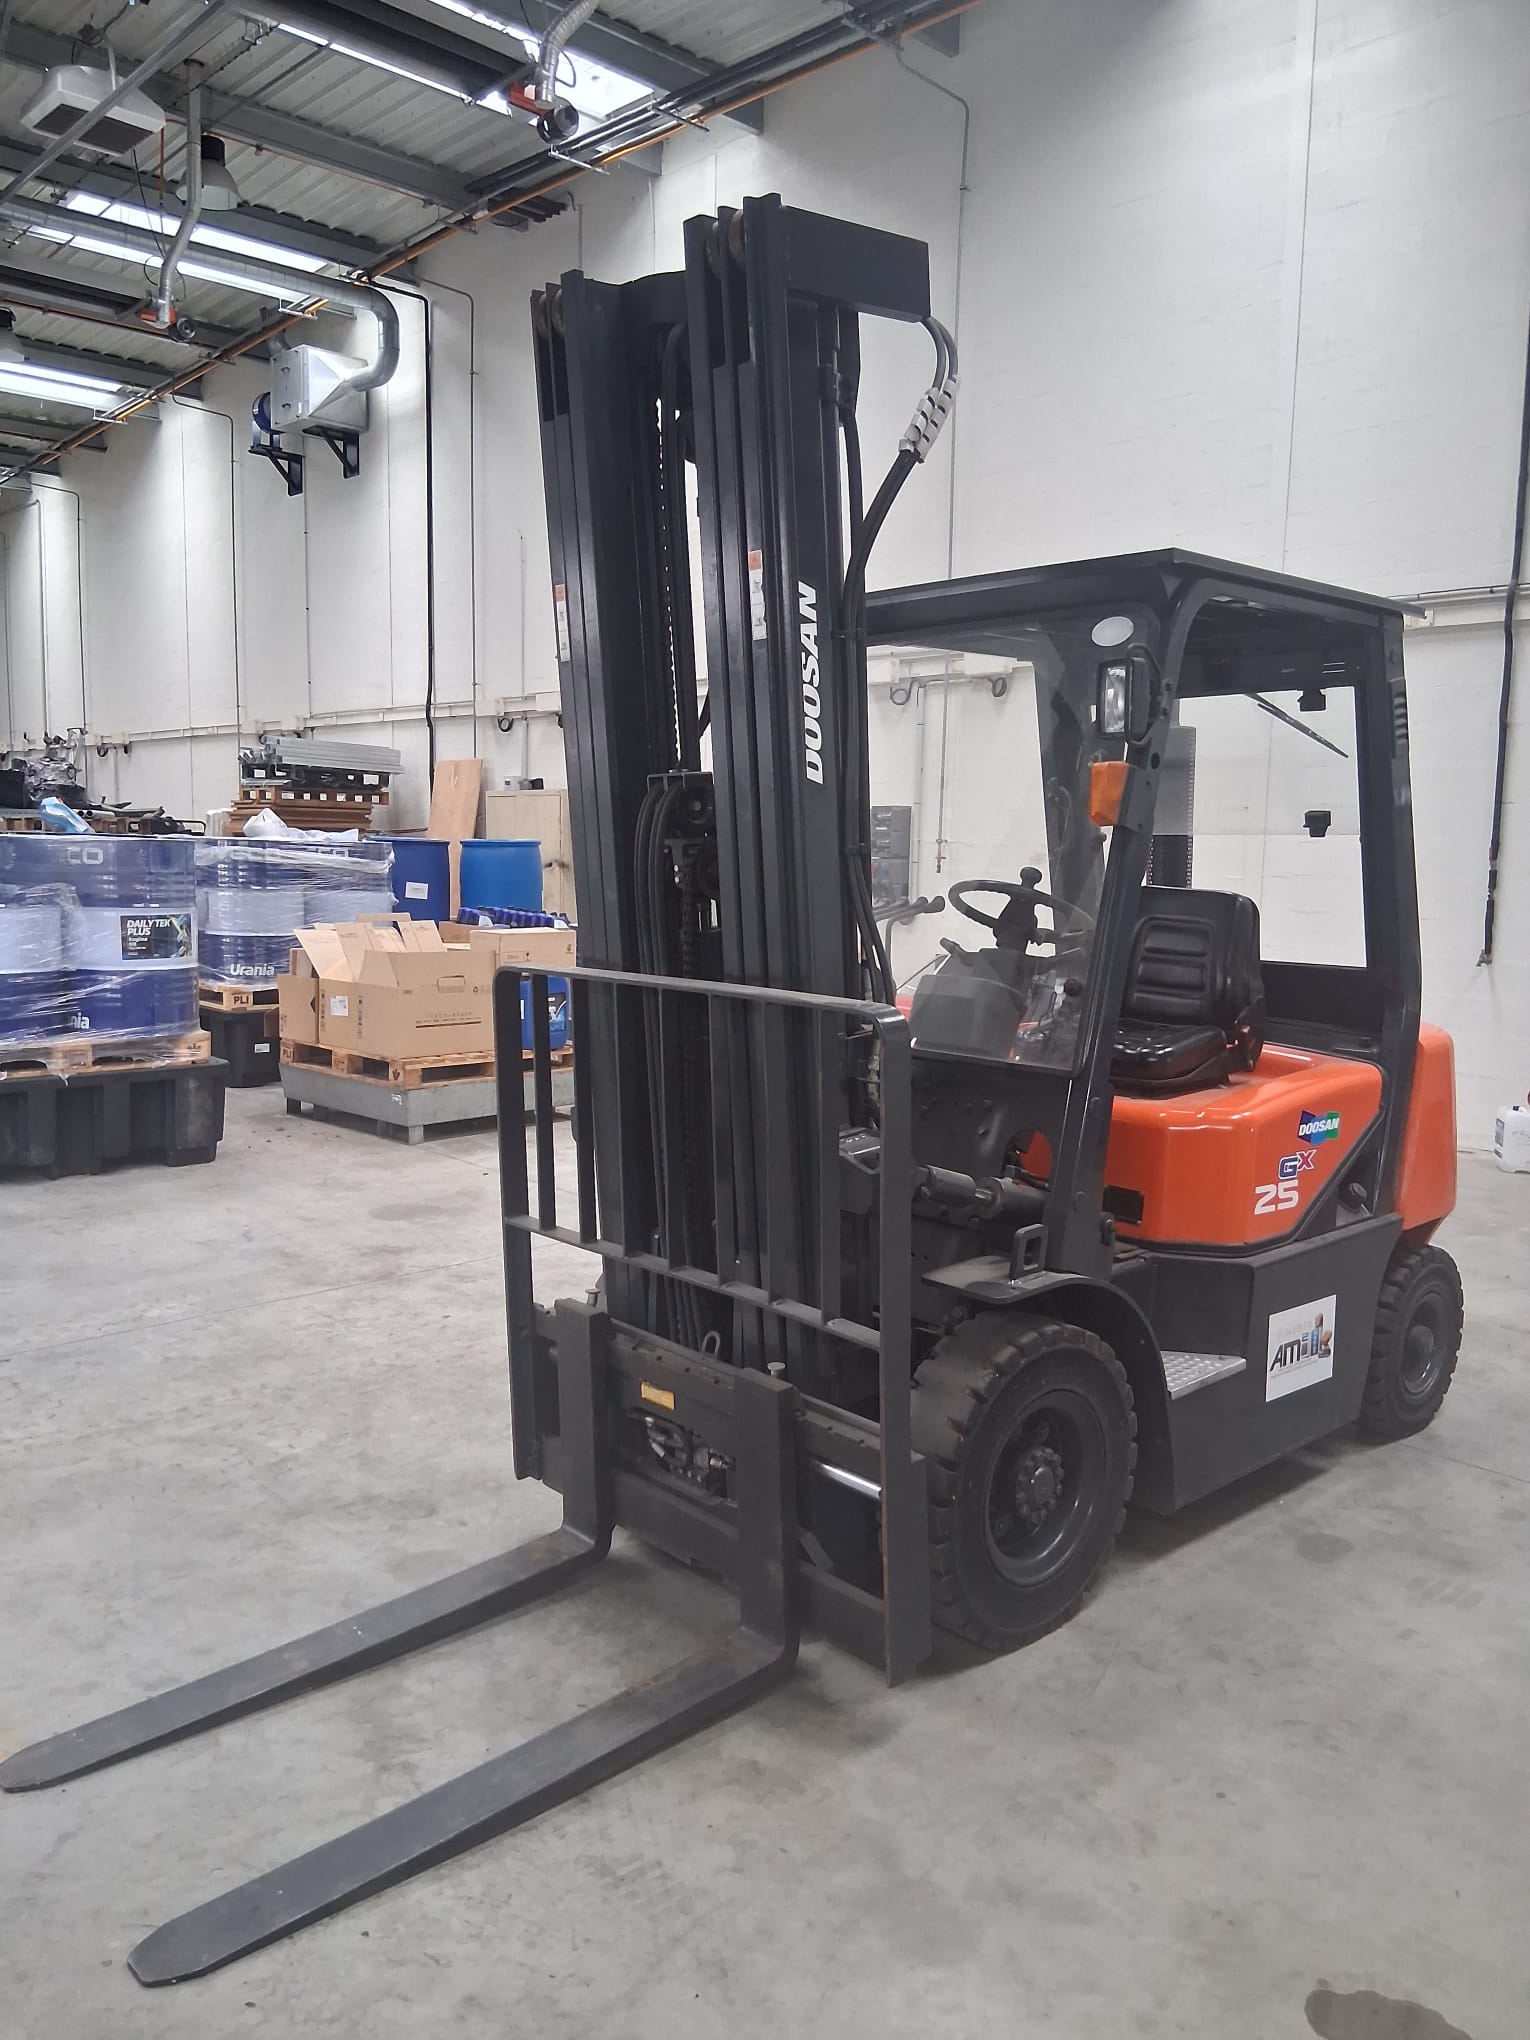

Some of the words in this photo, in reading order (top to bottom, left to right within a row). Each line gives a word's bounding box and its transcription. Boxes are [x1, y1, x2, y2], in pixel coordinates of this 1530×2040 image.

[798, 581, 824, 785] DOOSAN
[126, 919, 153, 928] DAILY
[154, 918, 171, 928] TEK
[127, 928, 152, 936] PLUS
[230, 963, 275, 976] Urania
[70, 1012, 91, 1030] nia
[1298, 1117, 1340, 1136] DOOSAN
[1278, 1149, 1318, 1180] GX
[1253, 1179, 1299, 1215] 25
